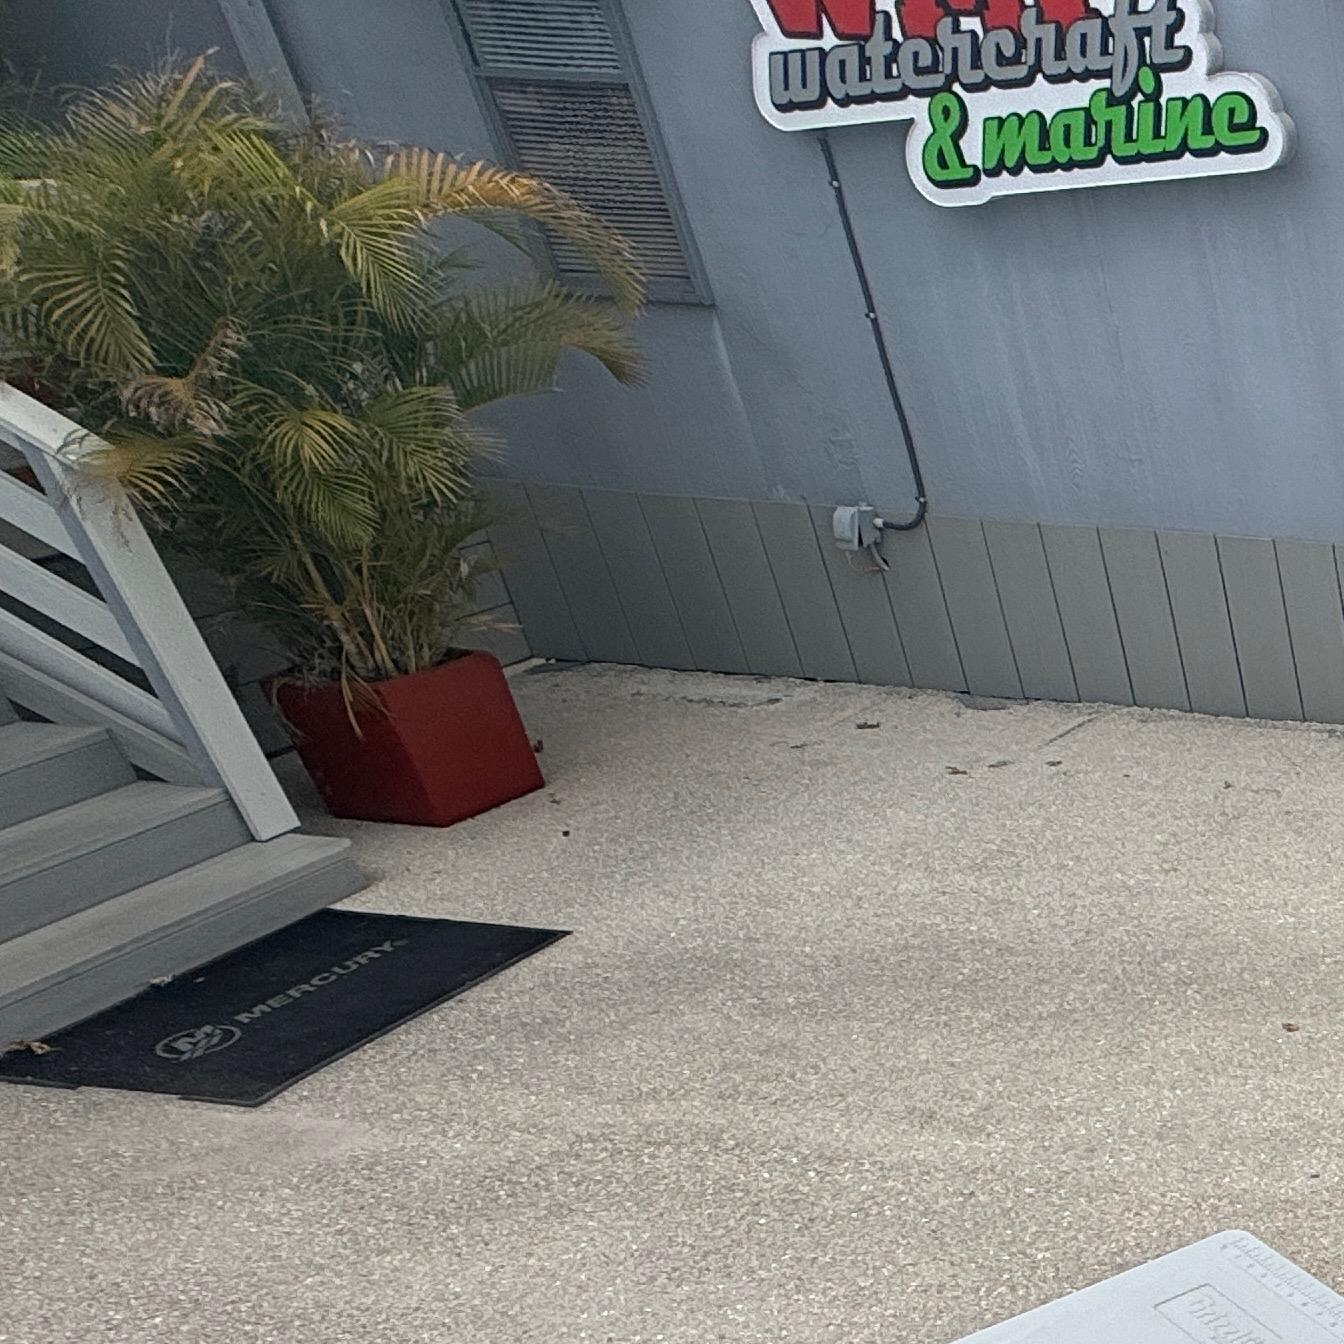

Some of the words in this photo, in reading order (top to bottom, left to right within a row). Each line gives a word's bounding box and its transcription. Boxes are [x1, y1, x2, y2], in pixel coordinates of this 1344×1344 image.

[769, 1, 1192, 110] watercraft
[922, 90, 982, 189] &
[981, 66, 1267, 179] marine
[234, 940, 396, 1024] MERCURY
